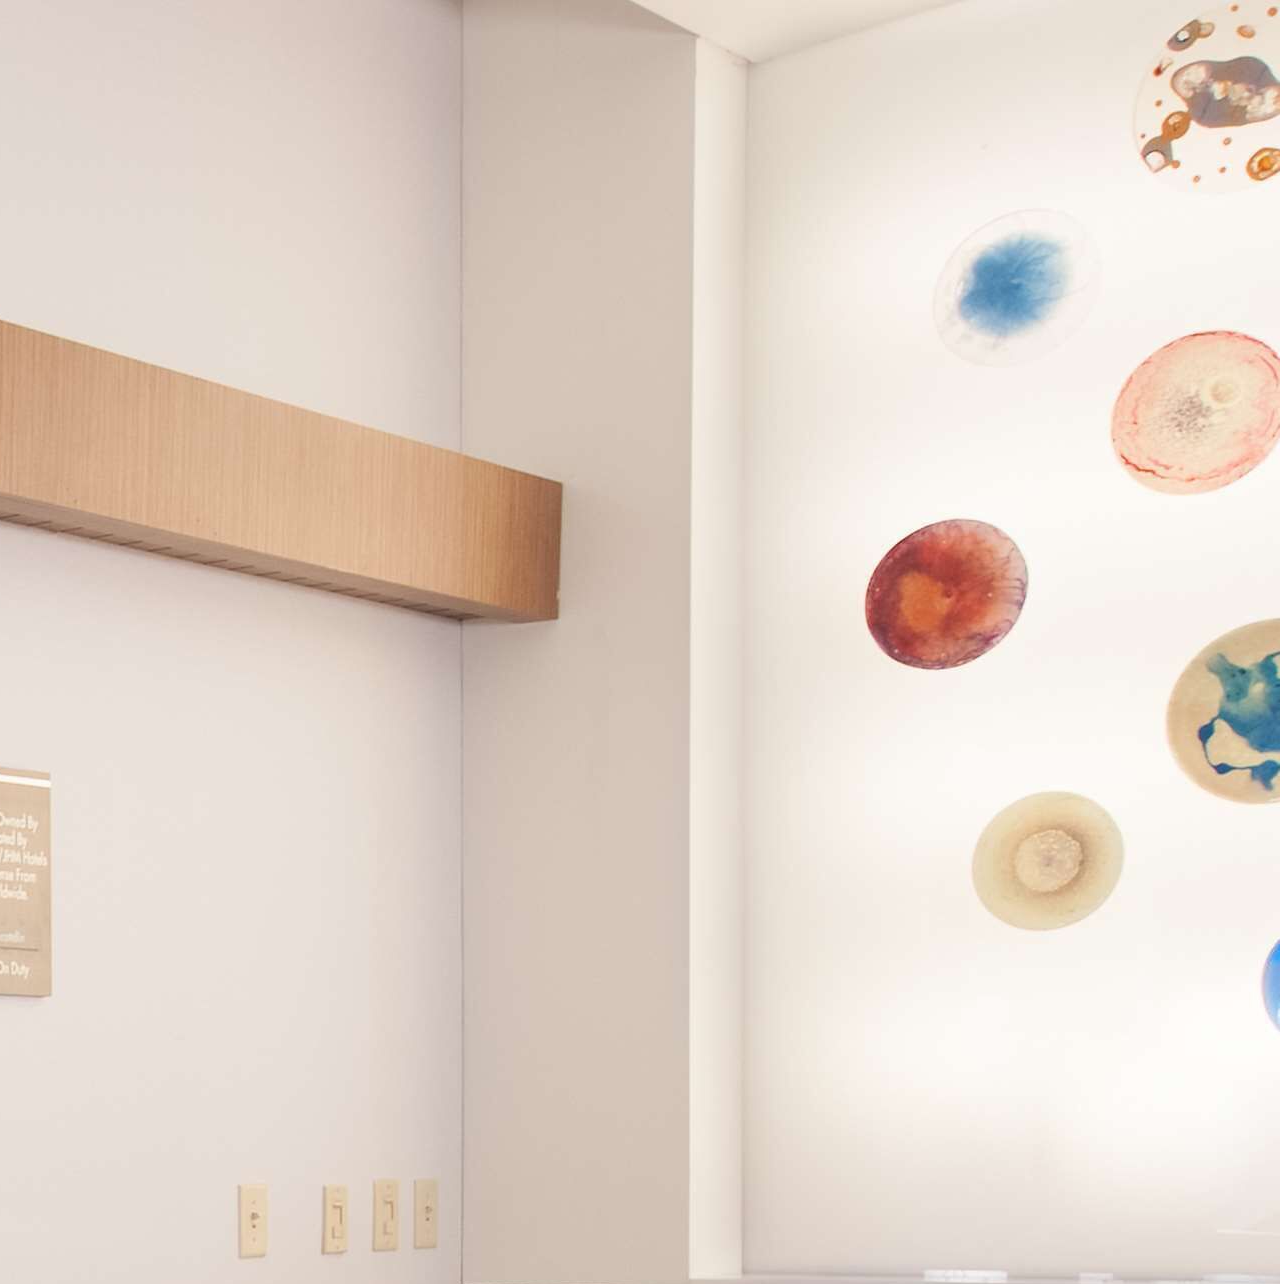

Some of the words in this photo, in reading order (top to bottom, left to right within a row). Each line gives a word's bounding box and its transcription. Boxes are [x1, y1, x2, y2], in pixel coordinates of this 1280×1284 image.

[28, 815, 39, 833] By
[17, 831, 28, 849] By
[15, 868, 37, 883] From
[10, 961, 31, 979] Duty
